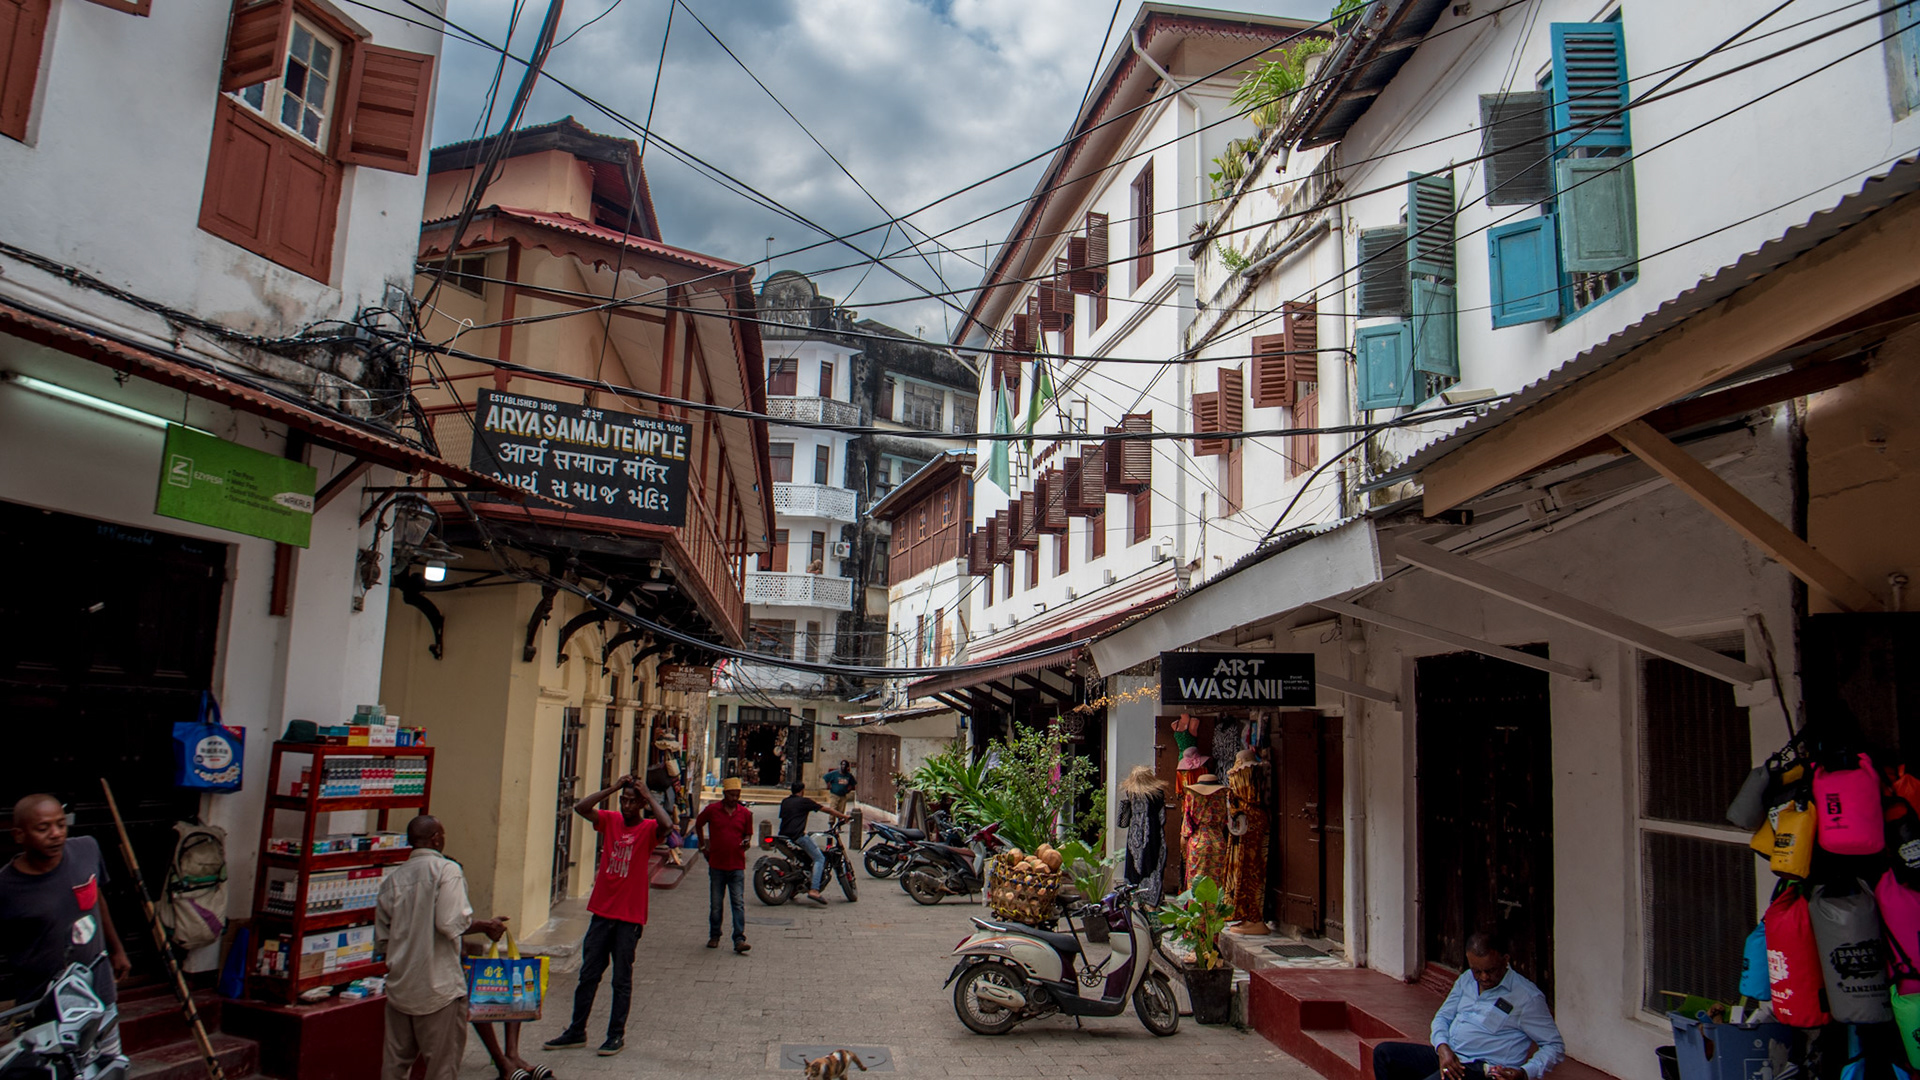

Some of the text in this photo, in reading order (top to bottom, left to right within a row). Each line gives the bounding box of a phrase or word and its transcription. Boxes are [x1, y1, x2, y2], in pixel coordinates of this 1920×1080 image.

[489, 393, 558, 412] ESTABLISHED 1906
[484, 405, 687, 460] ARYA SAMAJ TEMPLE
[498, 440, 670, 484] आर्य समाज मंदिर
[627, 485, 669, 512] મંદિર
[1213, 658, 1265, 676] ART
[1178, 677, 1284, 699] WASANII
[1830, 802, 1839, 814] 5
[611, 840, 633, 860] SUN
[606, 857, 630, 878] RUN
